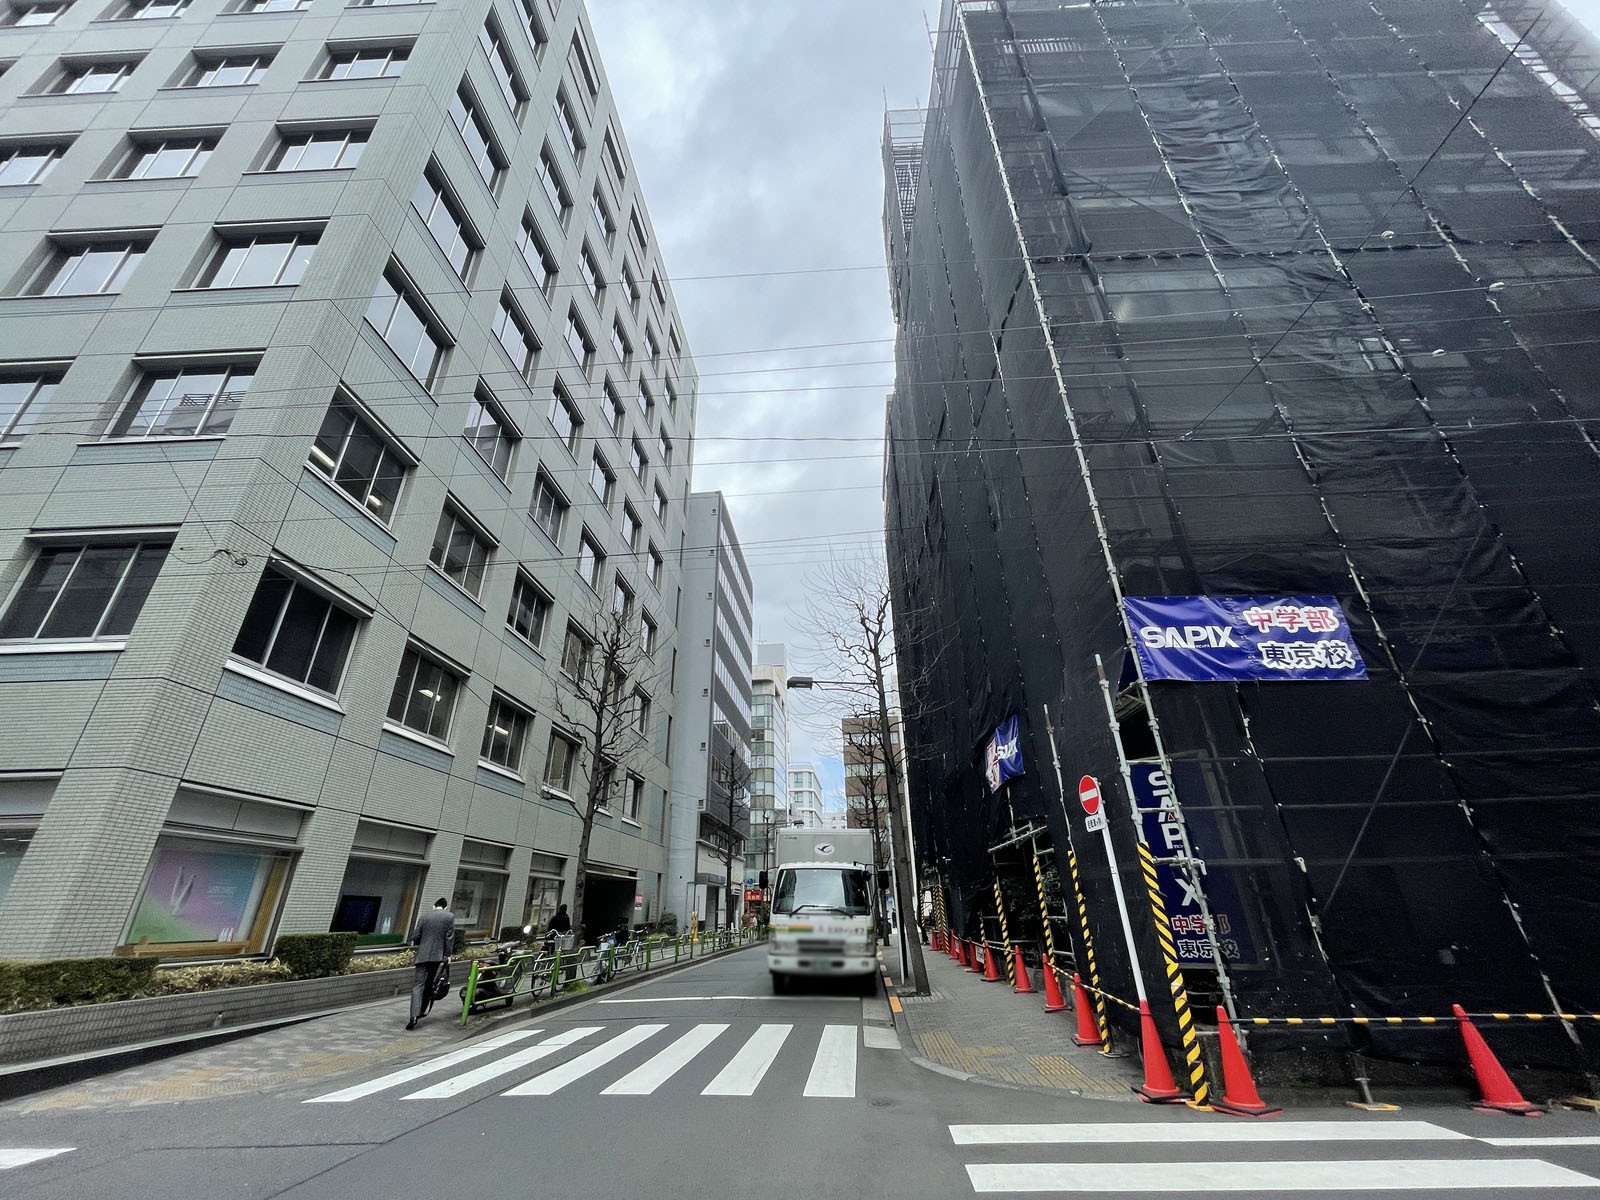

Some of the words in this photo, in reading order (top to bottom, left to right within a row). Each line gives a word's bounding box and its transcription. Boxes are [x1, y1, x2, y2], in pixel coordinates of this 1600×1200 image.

[1244, 606, 1338, 632] 中学部
[1140, 626, 1239, 648] SAPIX
[1259, 642, 1357, 669] 東京校
